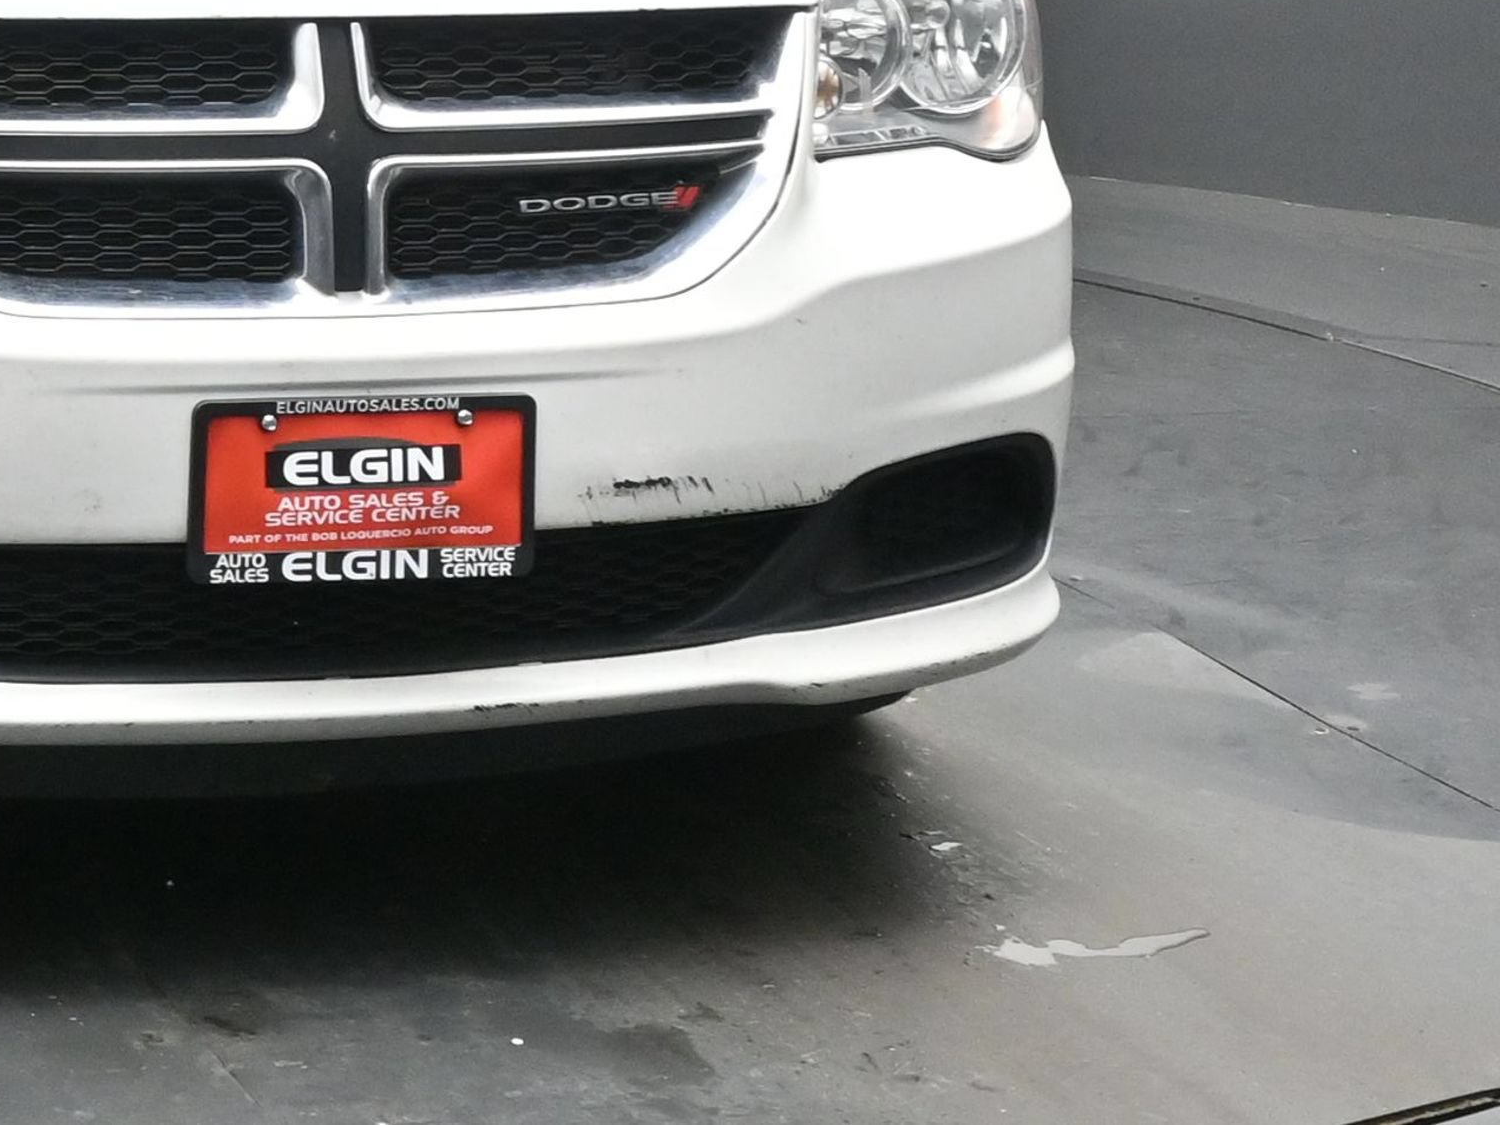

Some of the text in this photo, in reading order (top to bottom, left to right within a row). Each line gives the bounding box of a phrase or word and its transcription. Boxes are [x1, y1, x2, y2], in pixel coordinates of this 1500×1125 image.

[518, 191, 679, 213] DODGE
[276, 398, 459, 414] ELGINAUTOSALES.COM
[282, 447, 445, 486] ELGIN
[277, 491, 449, 512] AUTO SALES &
[265, 505, 459, 527] SERVICE CENTER
[229, 535, 261, 544] PART
[264, 534, 282, 543] OF
[285, 533, 308, 542] THE
[312, 532, 338, 541] BOB
[415, 526, 447, 536] AUTO
[450, 525, 493, 535] GROUP
[216, 553, 266, 569] AUTO
[440, 547, 515, 563] SERVICE
[282, 549, 428, 582] ELGIN
[442, 562, 511, 578] CENTER
[210, 569, 269, 584] SALES
